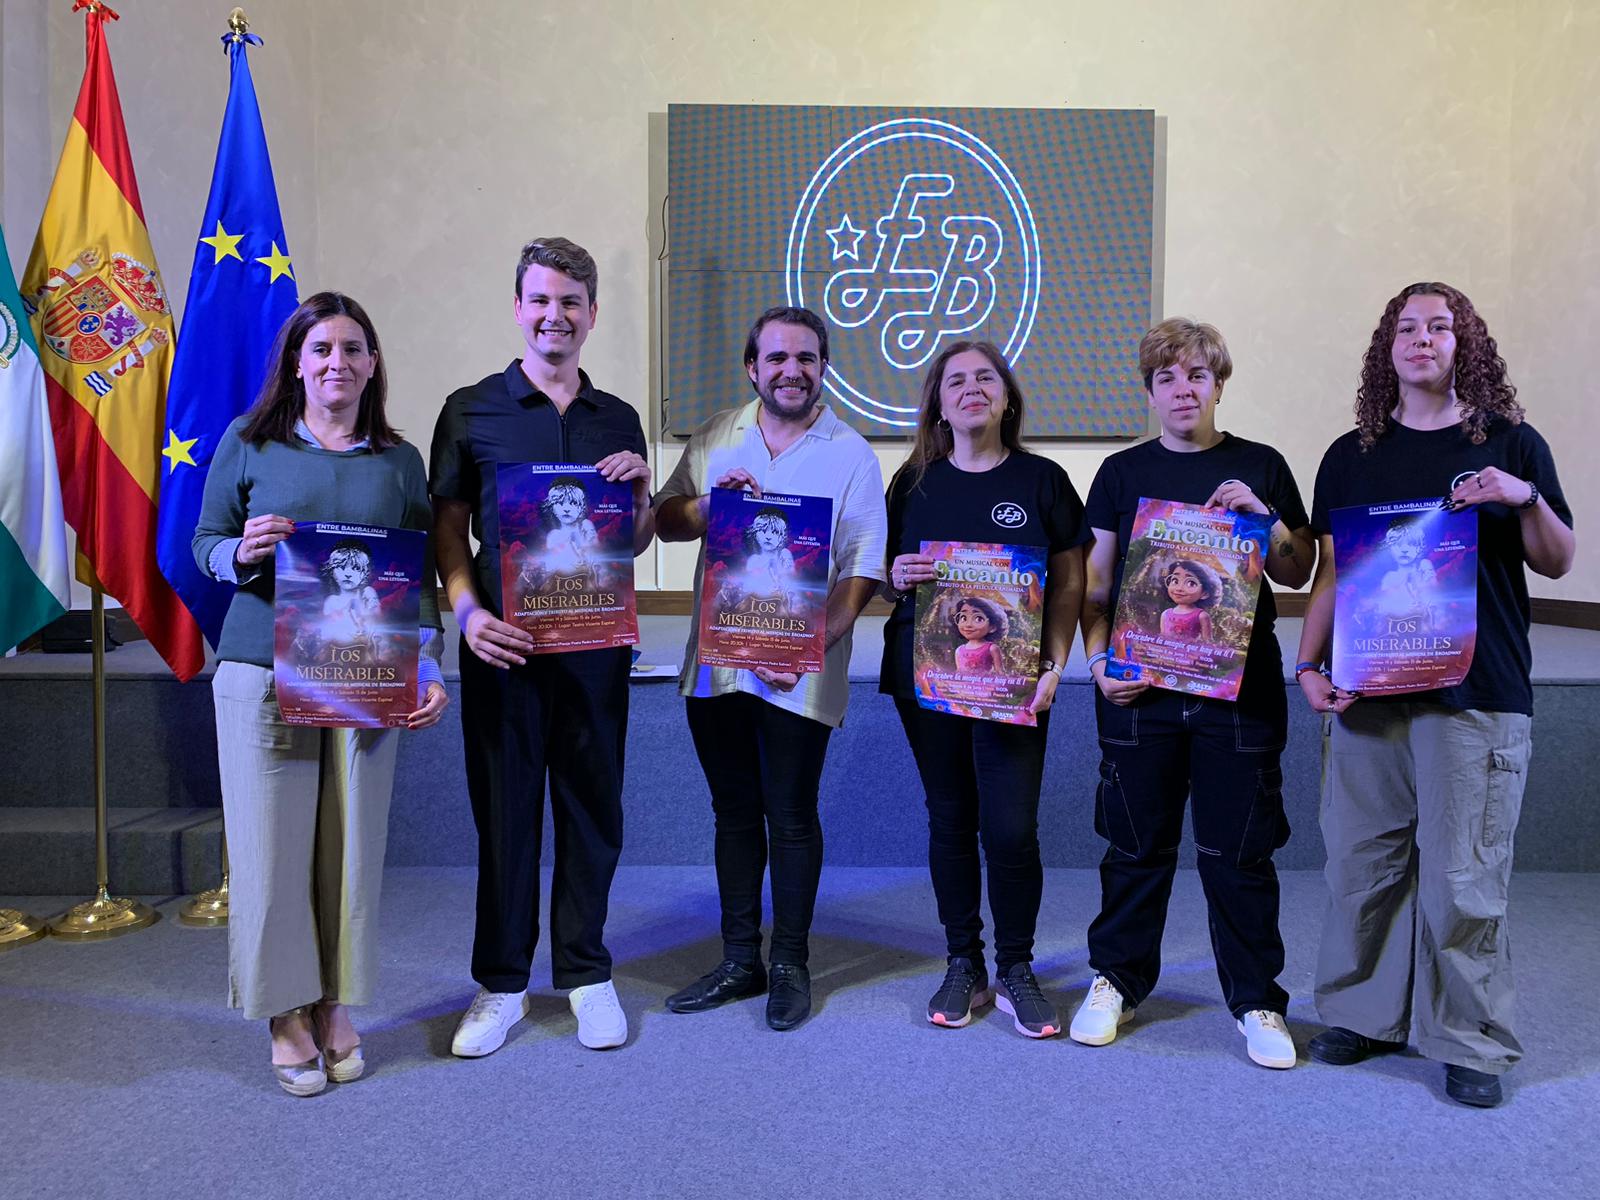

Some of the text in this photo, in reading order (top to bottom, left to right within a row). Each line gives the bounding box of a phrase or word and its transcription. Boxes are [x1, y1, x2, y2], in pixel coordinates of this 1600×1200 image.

[764, 495, 801, 503] BAMBALINAS
[341, 525, 388, 535] BAMBALINAS
[1185, 521, 1213, 530] MUSICAL
[1146, 518, 1254, 554] Encanto
[934, 560, 1033, 586] Encanto
[556, 576, 583, 593] LOS
[524, 594, 615, 610] MISERABLES
[751, 597, 776, 615] LOS
[719, 612, 806, 632] MISERABLES
[1388, 619, 1416, 636] LOS
[1354, 637, 1451, 651] MISERABLES
[331, 646, 361, 665] LOS
[296, 666, 395, 681] MISERABLES
